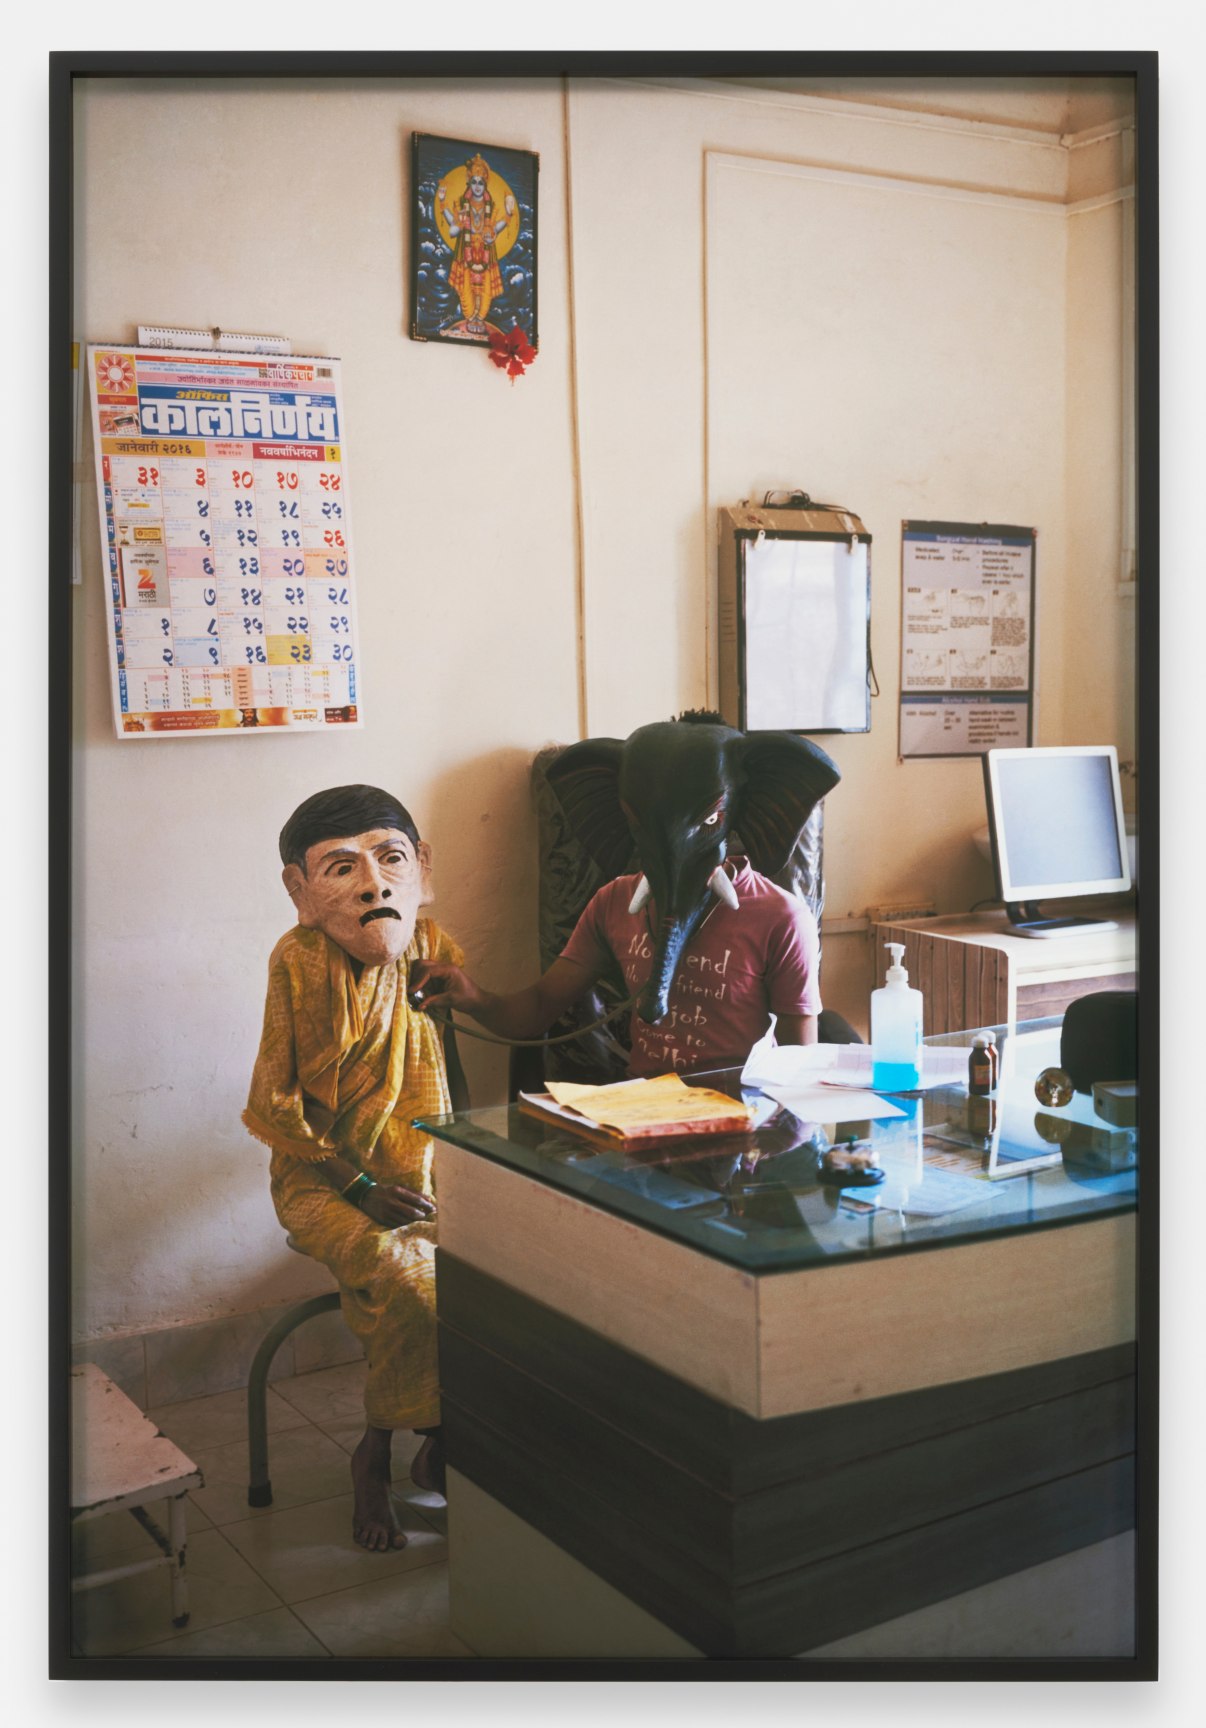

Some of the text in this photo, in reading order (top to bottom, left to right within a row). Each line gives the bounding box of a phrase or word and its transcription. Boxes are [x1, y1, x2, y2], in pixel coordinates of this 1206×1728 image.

[149, 337, 173, 347] 2015
[176, 389, 228, 402] ऑफिस
[140, 391, 337, 441] कालनिर्णय
[115, 440, 192, 454] जानेवारी २०१६
[259, 445, 318, 459] नववर्षाभिनंदन
[138, 466, 159, 486] ३१
[196, 468, 206, 487] ३
[232, 470, 253, 488] १०
[277, 471, 299, 489] १७
[319, 473, 341, 490] २४
[197, 500, 209, 517] ४
[235, 500, 253, 517] ११
[279, 501, 299, 518] १८
[322, 502, 342, 519] २५
[200, 529, 211, 546] ५
[237, 529, 257, 547] १२
[282, 530, 300, 547] १९
[324, 530, 345, 547] २६
[203, 557, 215, 576] ६
[239, 557, 259, 576] १३
[283, 559, 305, 576] २०
[326, 559, 348, 576] २७
[204, 588, 216, 606] ७
[241, 588, 262, 605] १४
[285, 588, 304, 605] २१
[328, 588, 349, 604] २८
[161, 618, 170, 636] १
[207, 618, 218, 635] ८
[243, 617, 263, 634] १५
[287, 617, 309, 634] २२
[330, 616, 348, 633] २९
[163, 648, 174, 666] २
[208, 647, 219, 665] ९
[246, 646, 267, 664] १६
[291, 644, 312, 662] २३
[333, 644, 353, 661] ३०
[629, 932, 652, 959] No
[676, 974, 727, 1000] friend
[670, 1004, 708, 1029] job
